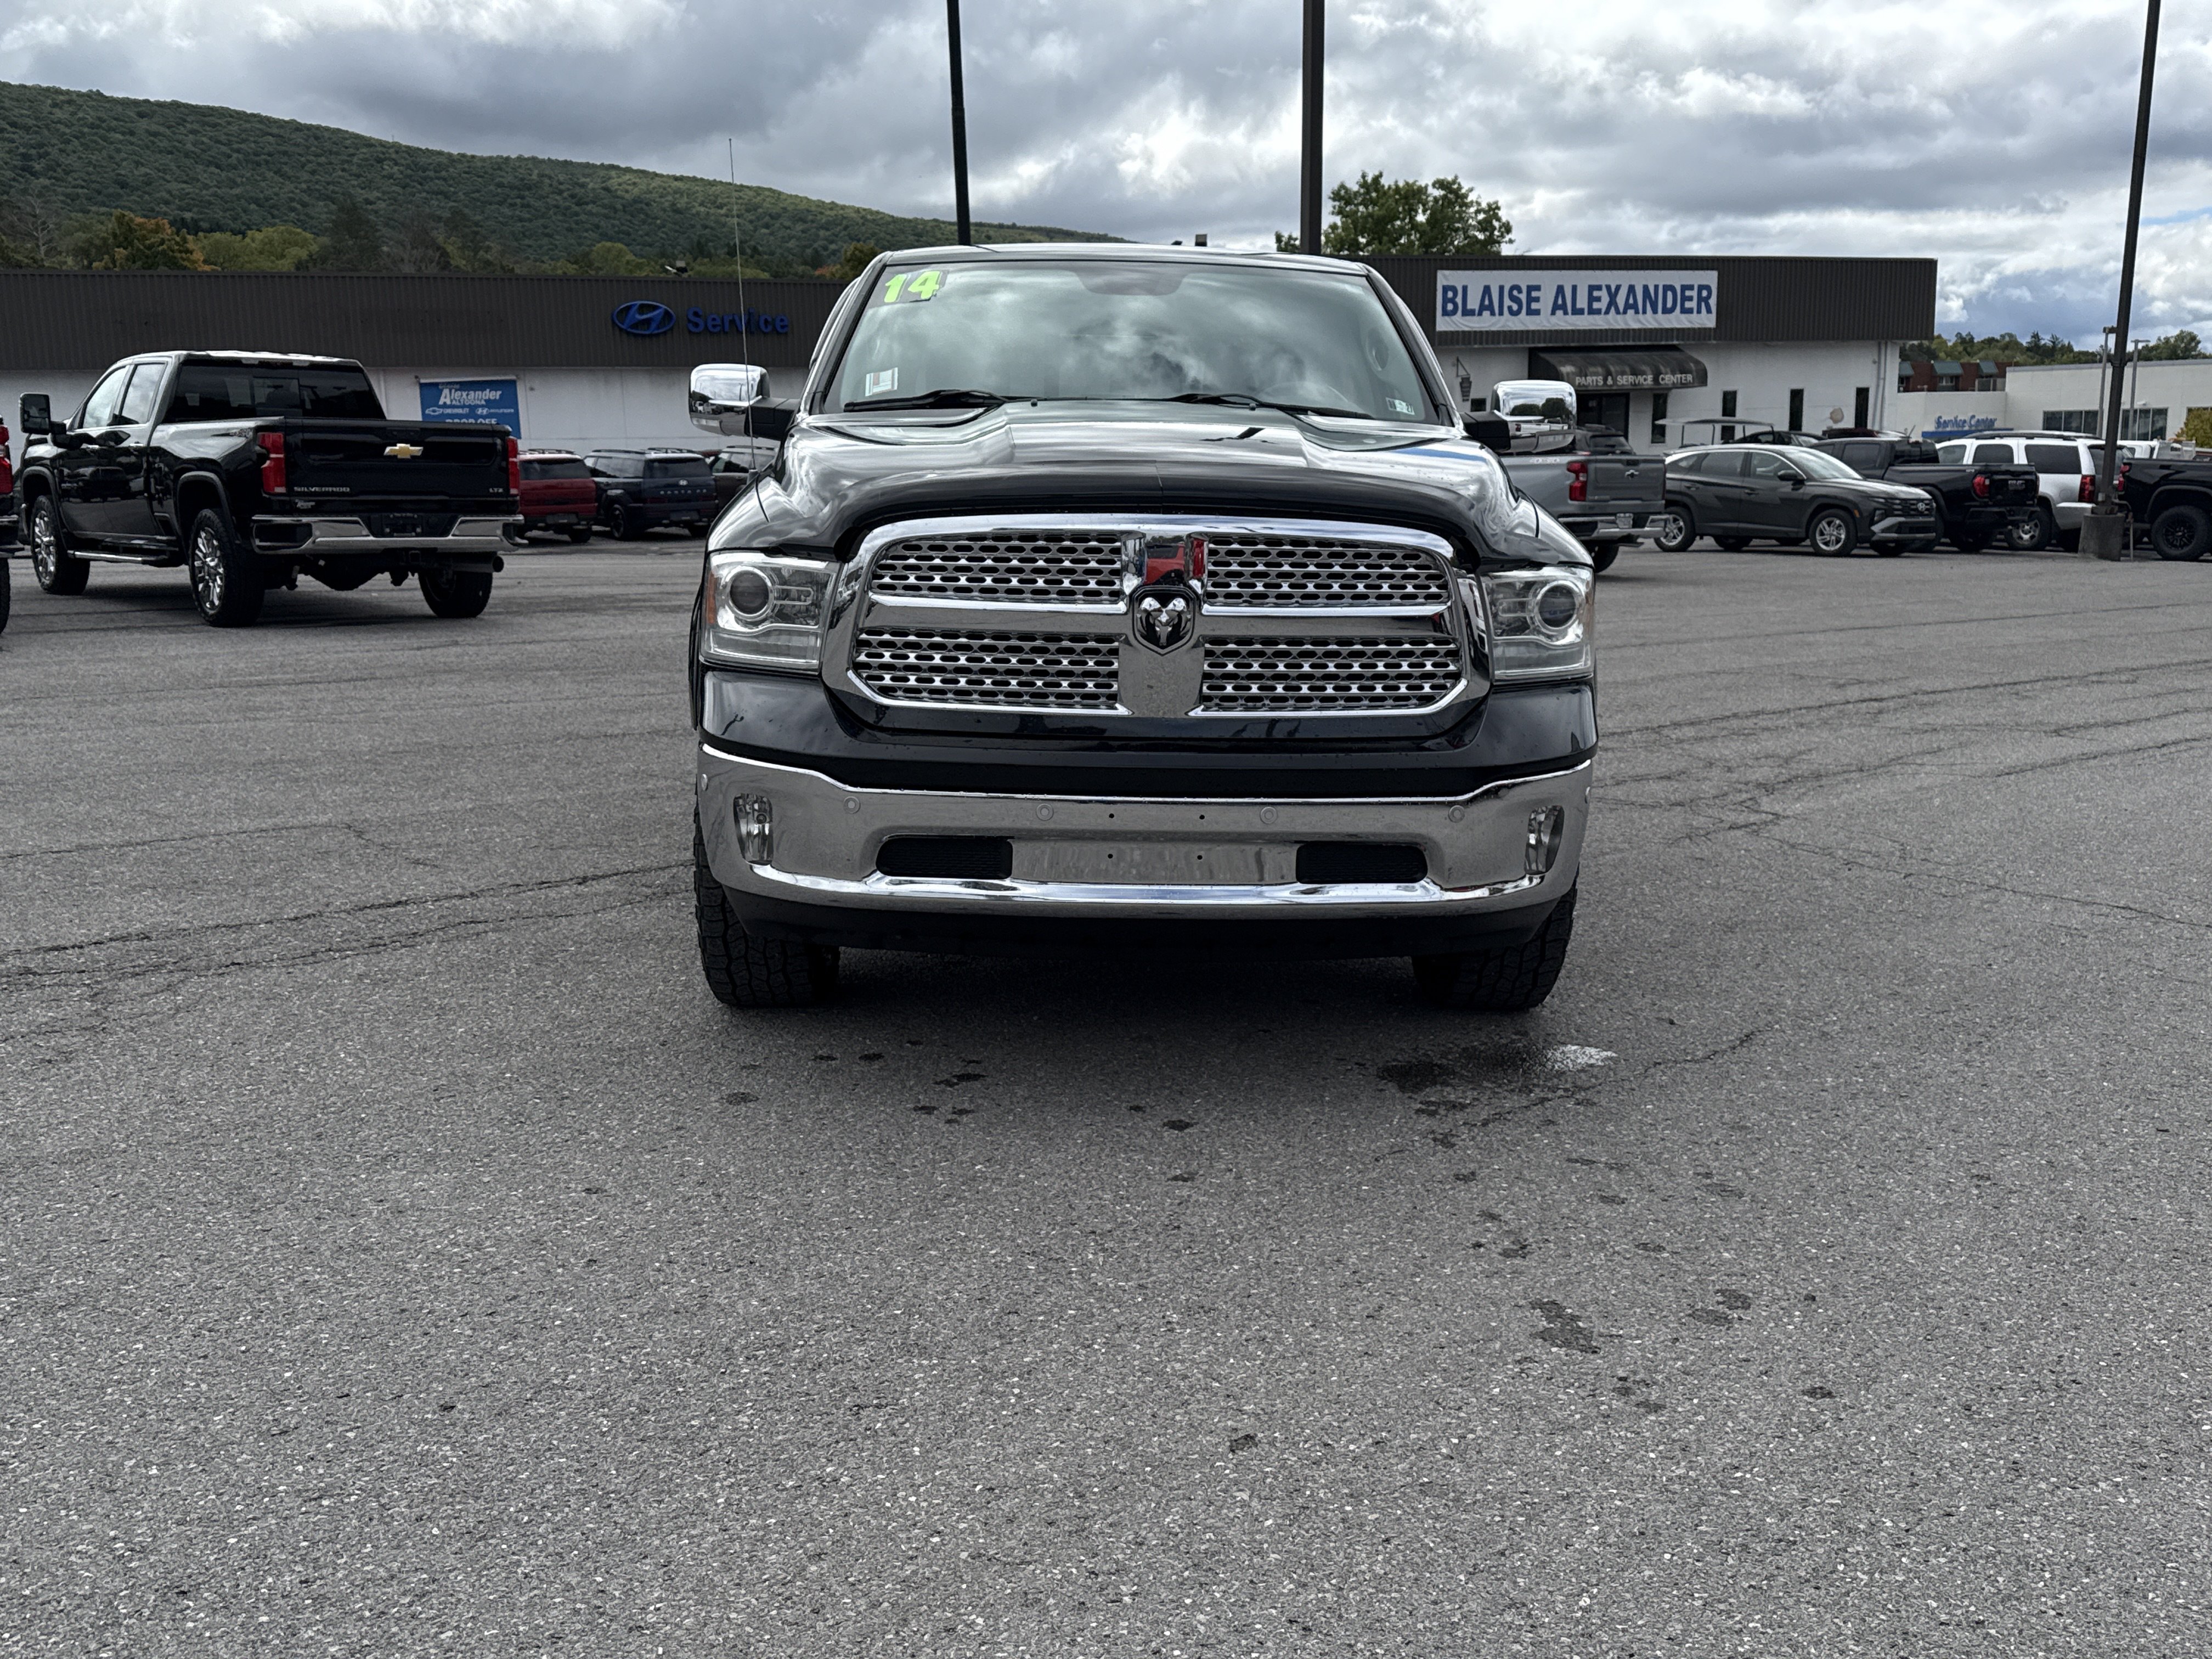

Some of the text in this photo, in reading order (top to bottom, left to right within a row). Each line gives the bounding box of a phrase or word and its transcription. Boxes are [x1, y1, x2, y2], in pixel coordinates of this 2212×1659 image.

[884, 270, 940, 303] 14
[1441, 284, 1713, 317] BLAISE ALEXANDER
[686, 306, 789, 334] Service
[1575, 374, 1693, 386] PARTS & SERVICE CENTER
[438, 388, 502, 405] Alexander
[1935, 415, 1967, 430] Service
